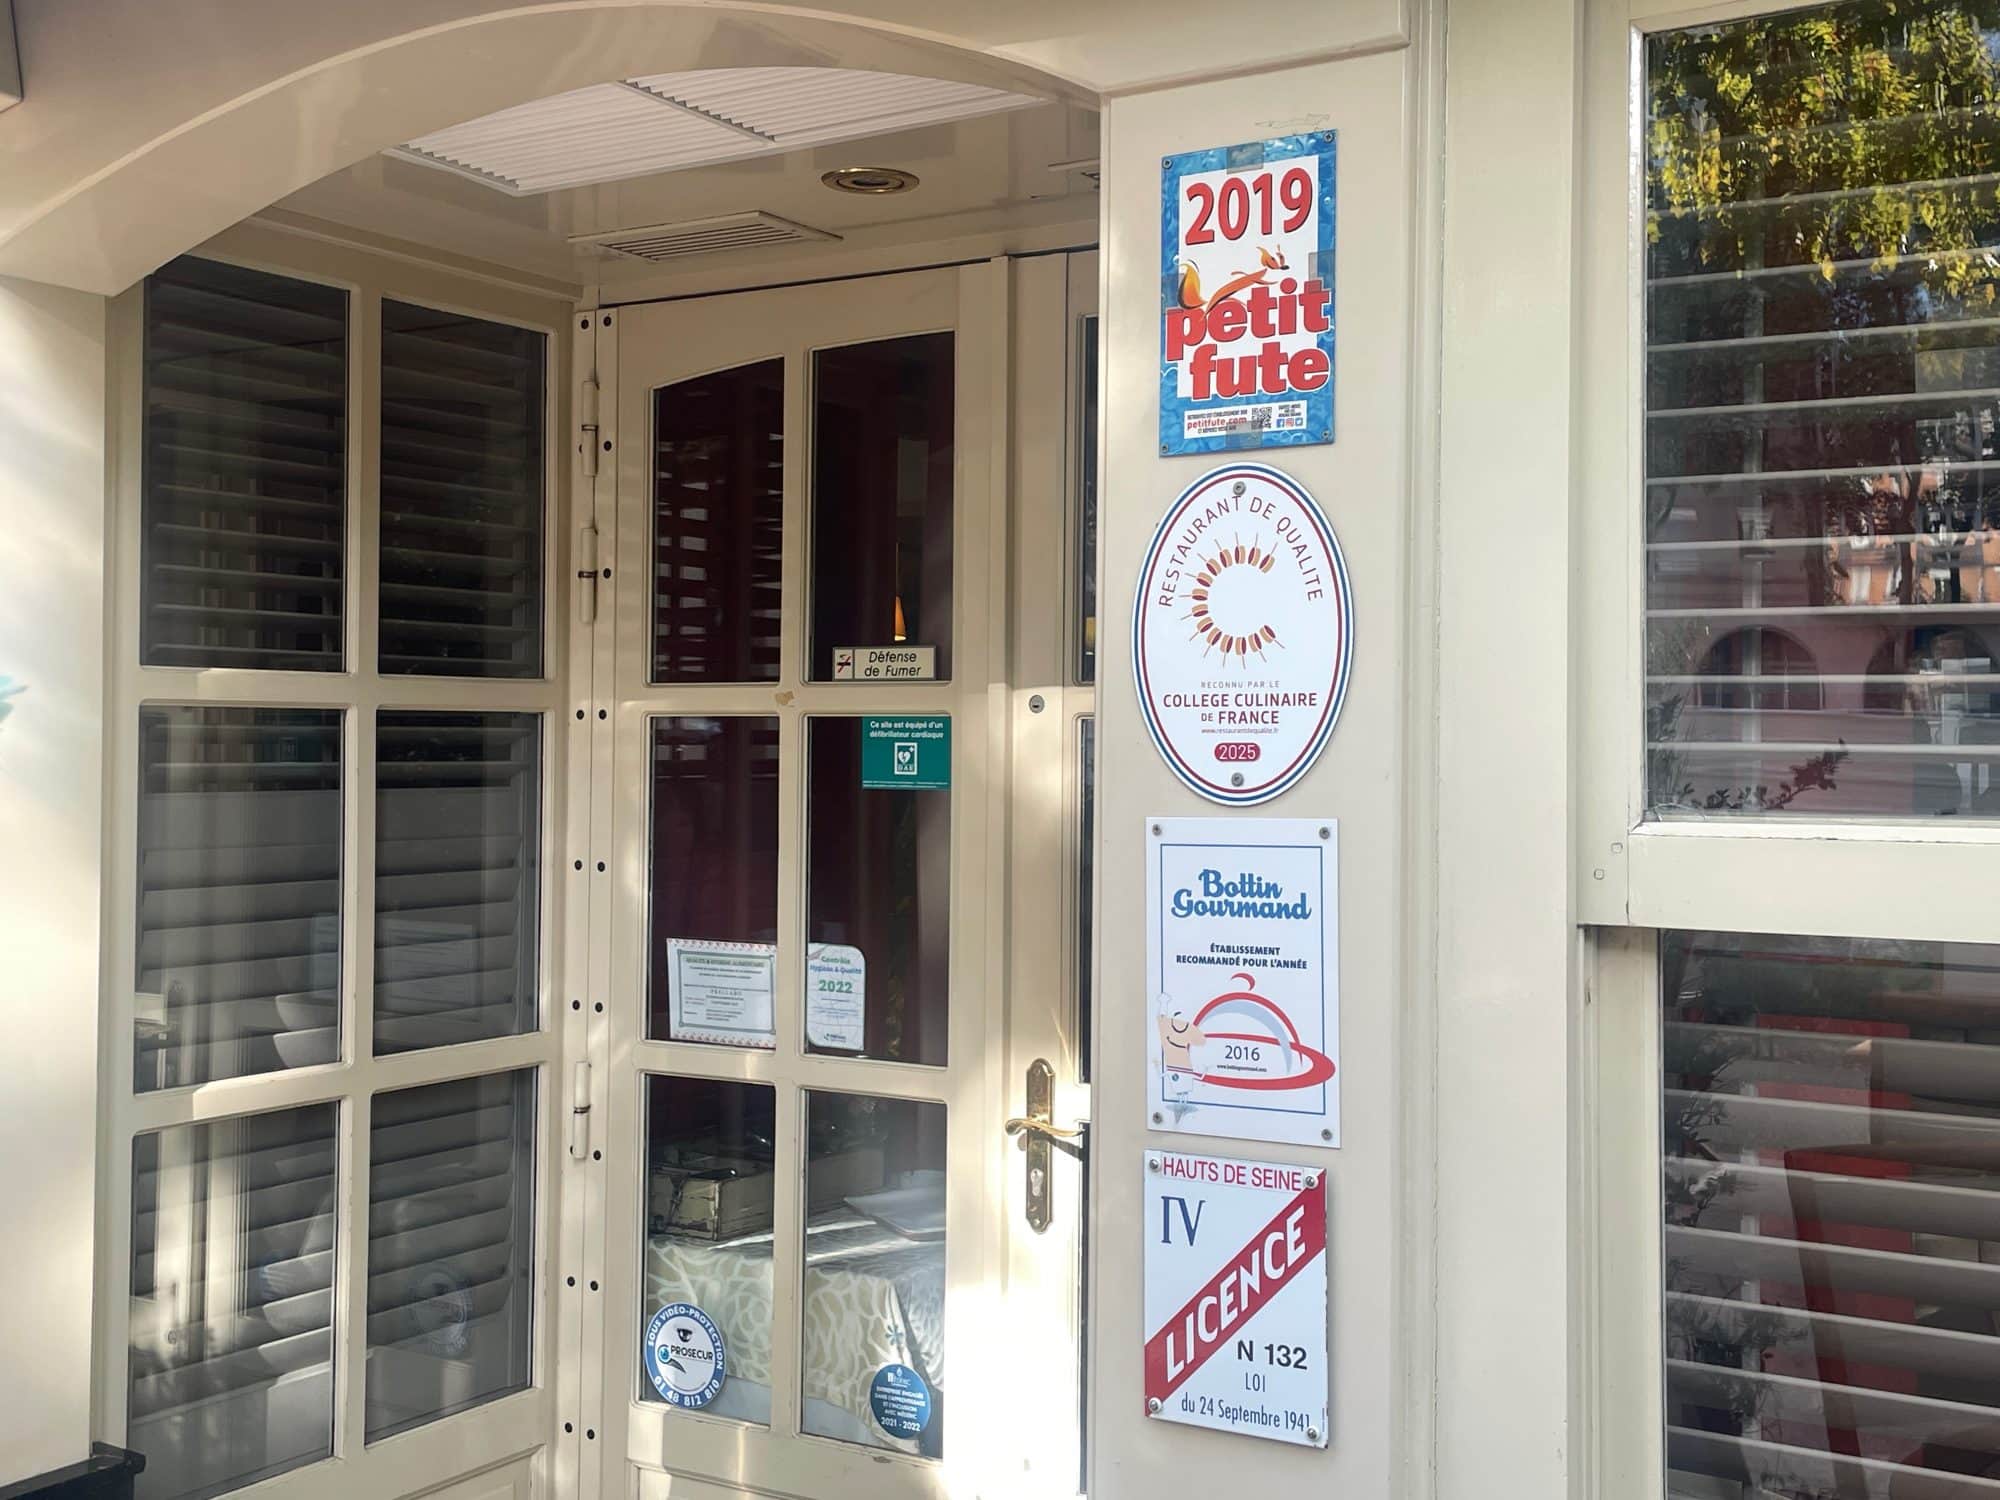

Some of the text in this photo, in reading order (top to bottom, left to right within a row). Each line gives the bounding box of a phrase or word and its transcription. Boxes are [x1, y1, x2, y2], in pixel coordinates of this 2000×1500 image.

[1185, 167, 1313, 246] 2019
[1166, 277, 1330, 361] petit
[1190, 342, 1329, 400] fute
[1186, 417, 1248, 431] petitfute.com
[1158, 495, 1324, 607] RESTAURANT DE QUALITE
[868, 650, 917, 663] Défense
[864, 665, 922, 677] de Fumer
[1200, 681, 1244, 689] RECONNU
[1269, 680, 1280, 688] LE
[1163, 692, 1318, 708] COLLEGE CULINAIRE
[870, 720, 944, 731] Ce site est équipé d'un
[1201, 711, 1280, 725] DE FRANCE
[869, 730, 944, 740] défibrillateur cardiaque
[1218, 744, 1257, 760] 2025
[1198, 868, 1283, 899] Bottin
[1171, 888, 1313, 919] Gourmand
[1210, 942, 1280, 956] ÉTABLISSEMENT
[1176, 954, 1308, 970] RECOMMANDÉ POUR L'ANNÉE
[818, 979, 853, 994] 2022
[1224, 1045, 1260, 1061] 2016
[1163, 1156, 1302, 1191] HAUTS DE SEINE
[1161, 1195, 1206, 1247] IV
[1165, 1205, 1306, 1383] LICENCE
[648, 1319, 661, 1347] SOUS
[670, 1345, 714, 1361] PROSECUR
[1237, 1340, 1308, 1370] N 132
[1245, 1372, 1266, 1393] LOI
[654, 1375, 720, 1407] 01 48 812 810
[1181, 1392, 1195, 1413] du
[1199, 1396, 1214, 1416] 24
[1218, 1399, 1280, 1428] Septembre
[1284, 1410, 1311, 1432] 1941
[881, 1417, 897, 1427] 2021
[903, 1420, 921, 1432] 2022
